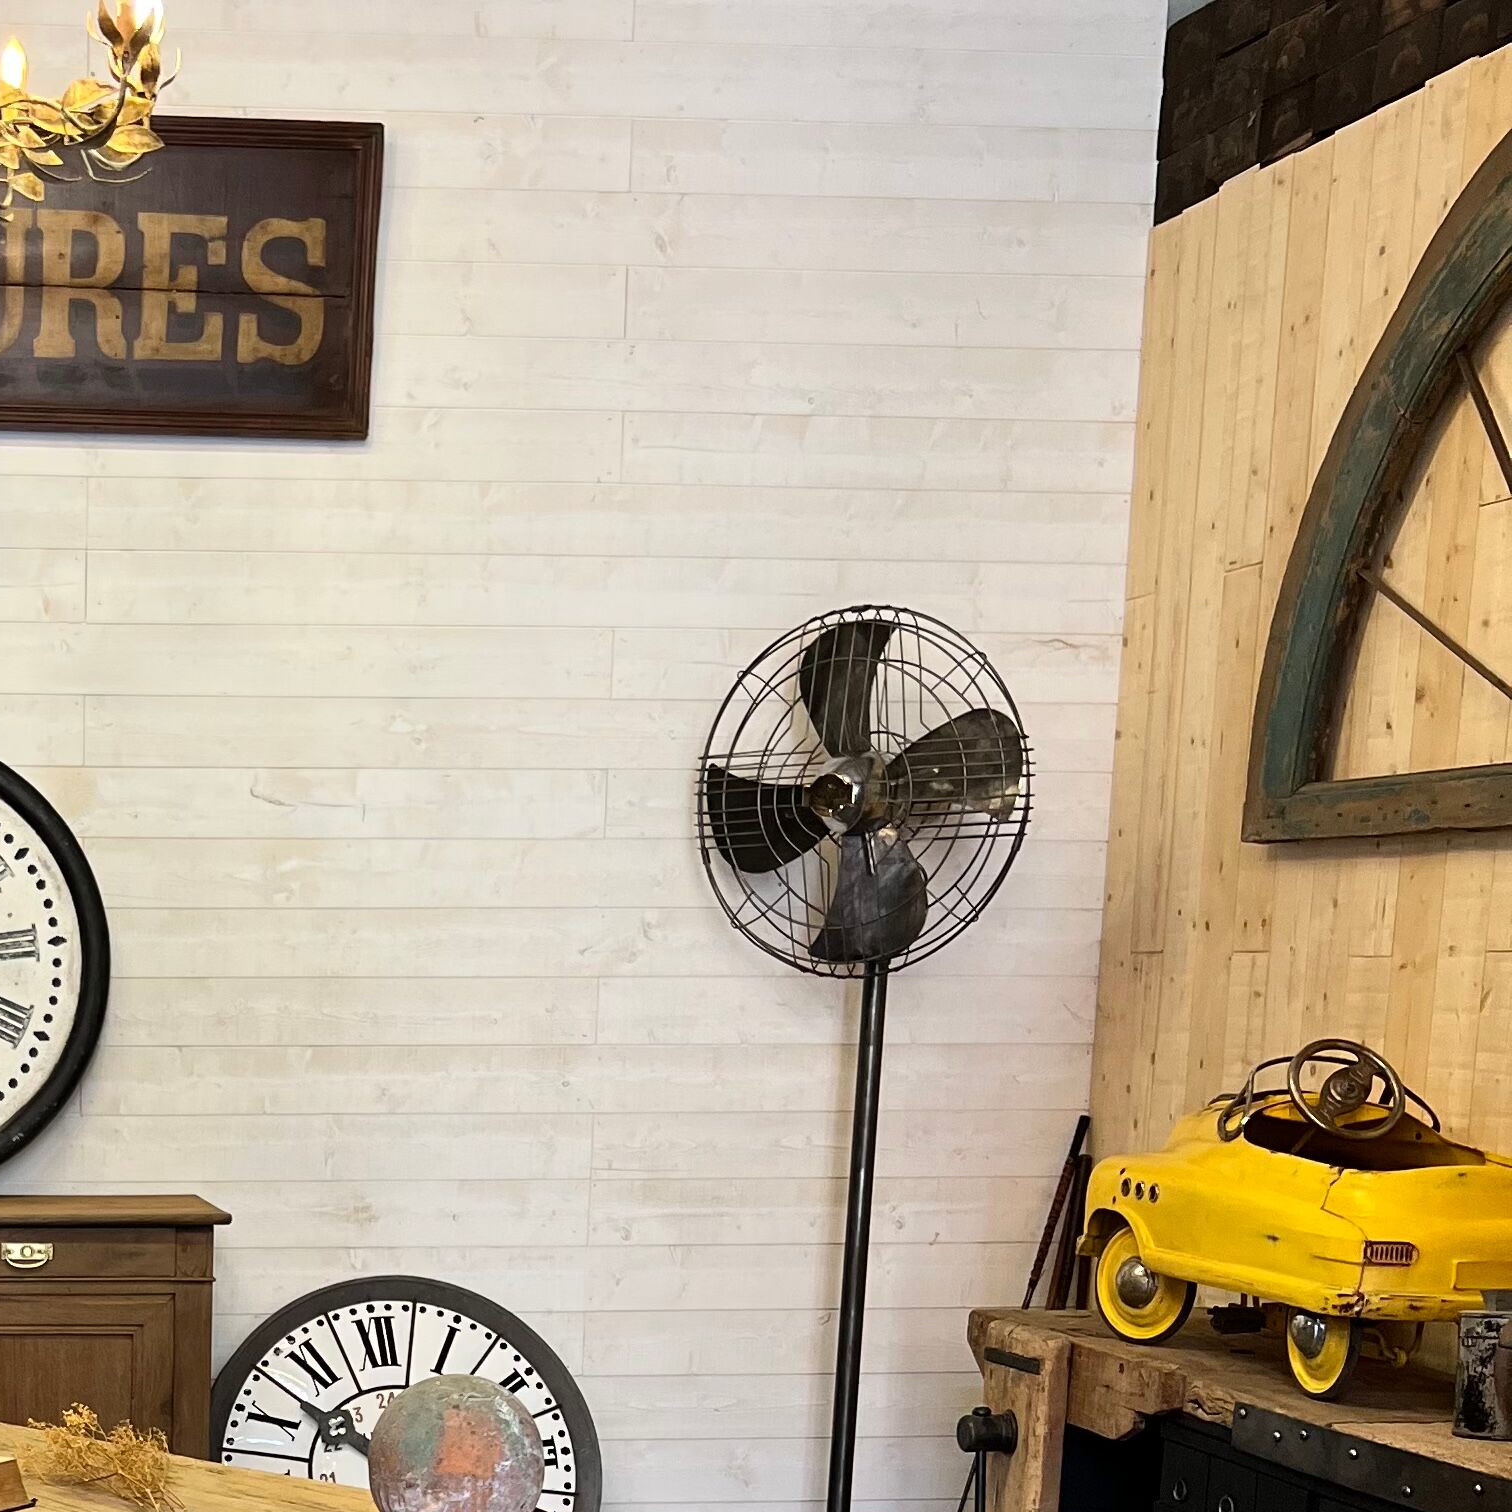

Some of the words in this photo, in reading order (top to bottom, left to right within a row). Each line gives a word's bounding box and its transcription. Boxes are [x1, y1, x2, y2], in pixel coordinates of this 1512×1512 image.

[284, 1338, 344, 1398] XI
[351, 1316, 403, 1373] XII
[430, 1324, 462, 1375] I
[245, 1400, 302, 1442] X
